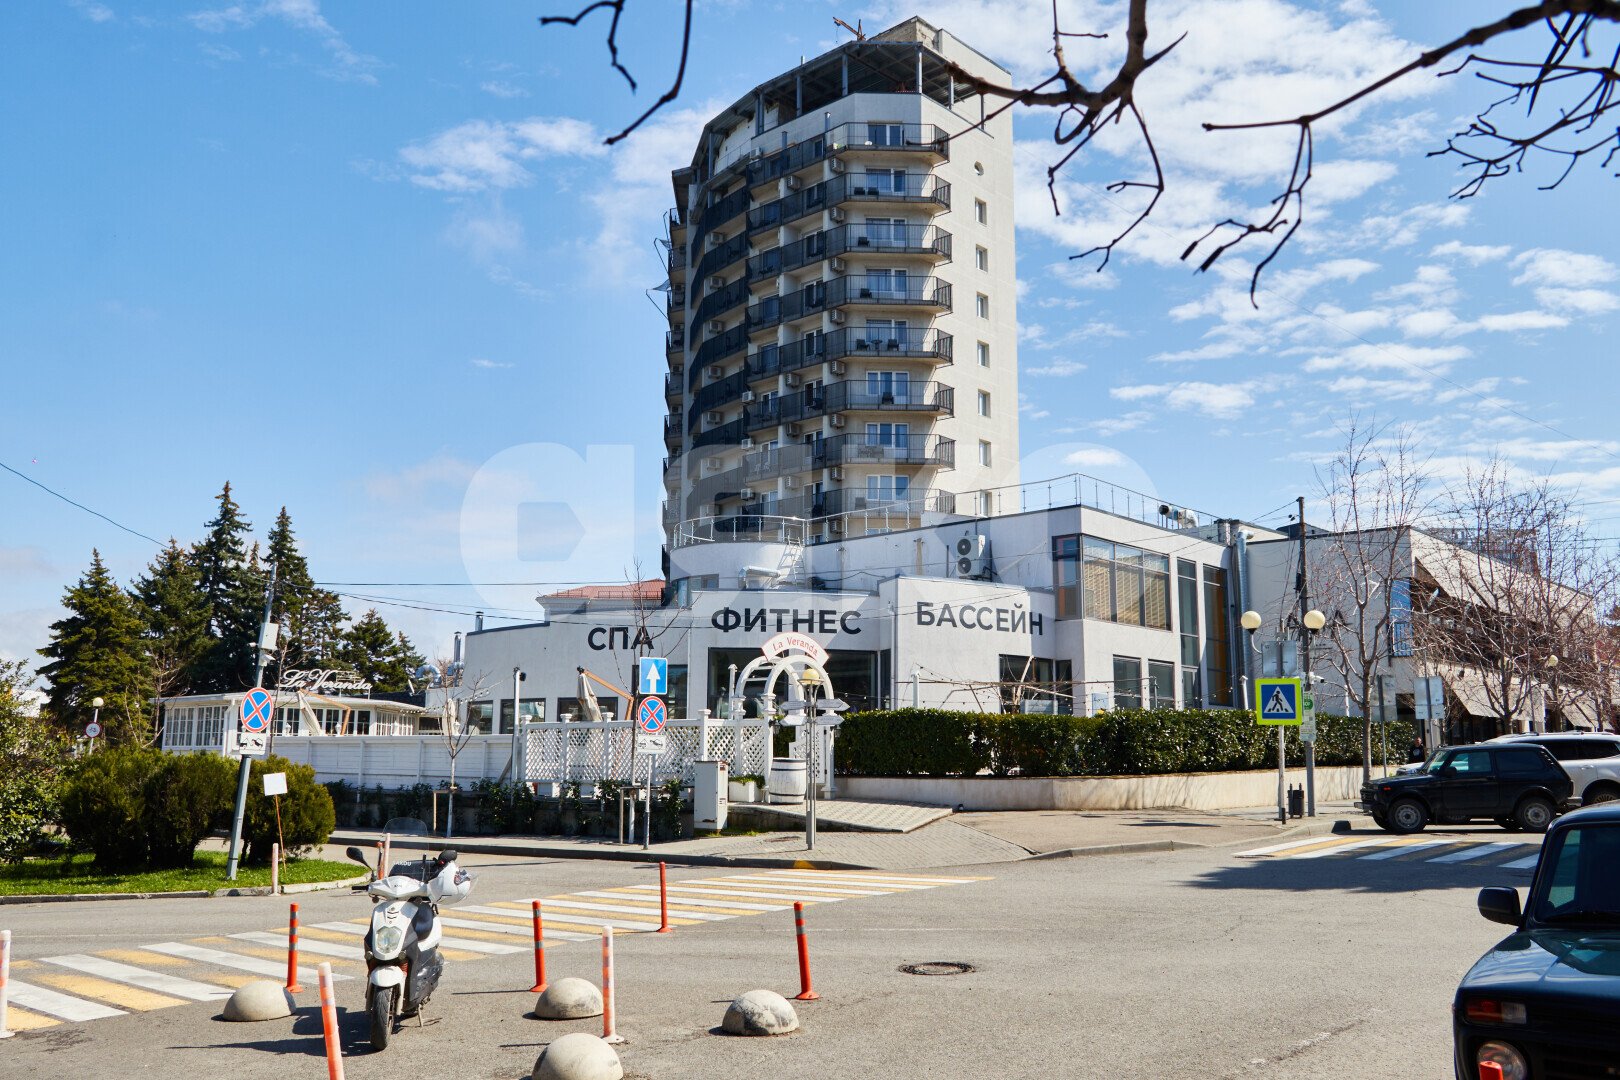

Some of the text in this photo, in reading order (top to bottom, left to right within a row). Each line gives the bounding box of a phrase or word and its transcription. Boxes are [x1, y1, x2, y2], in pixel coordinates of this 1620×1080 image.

[711, 606, 862, 635] ФИТНЕС
[916, 601, 1043, 635] БАССЕЙН
[587, 626, 654, 651] СПА
[772, 637, 818, 656] La Veranda
[275, 668, 373, 690] La Veranda
